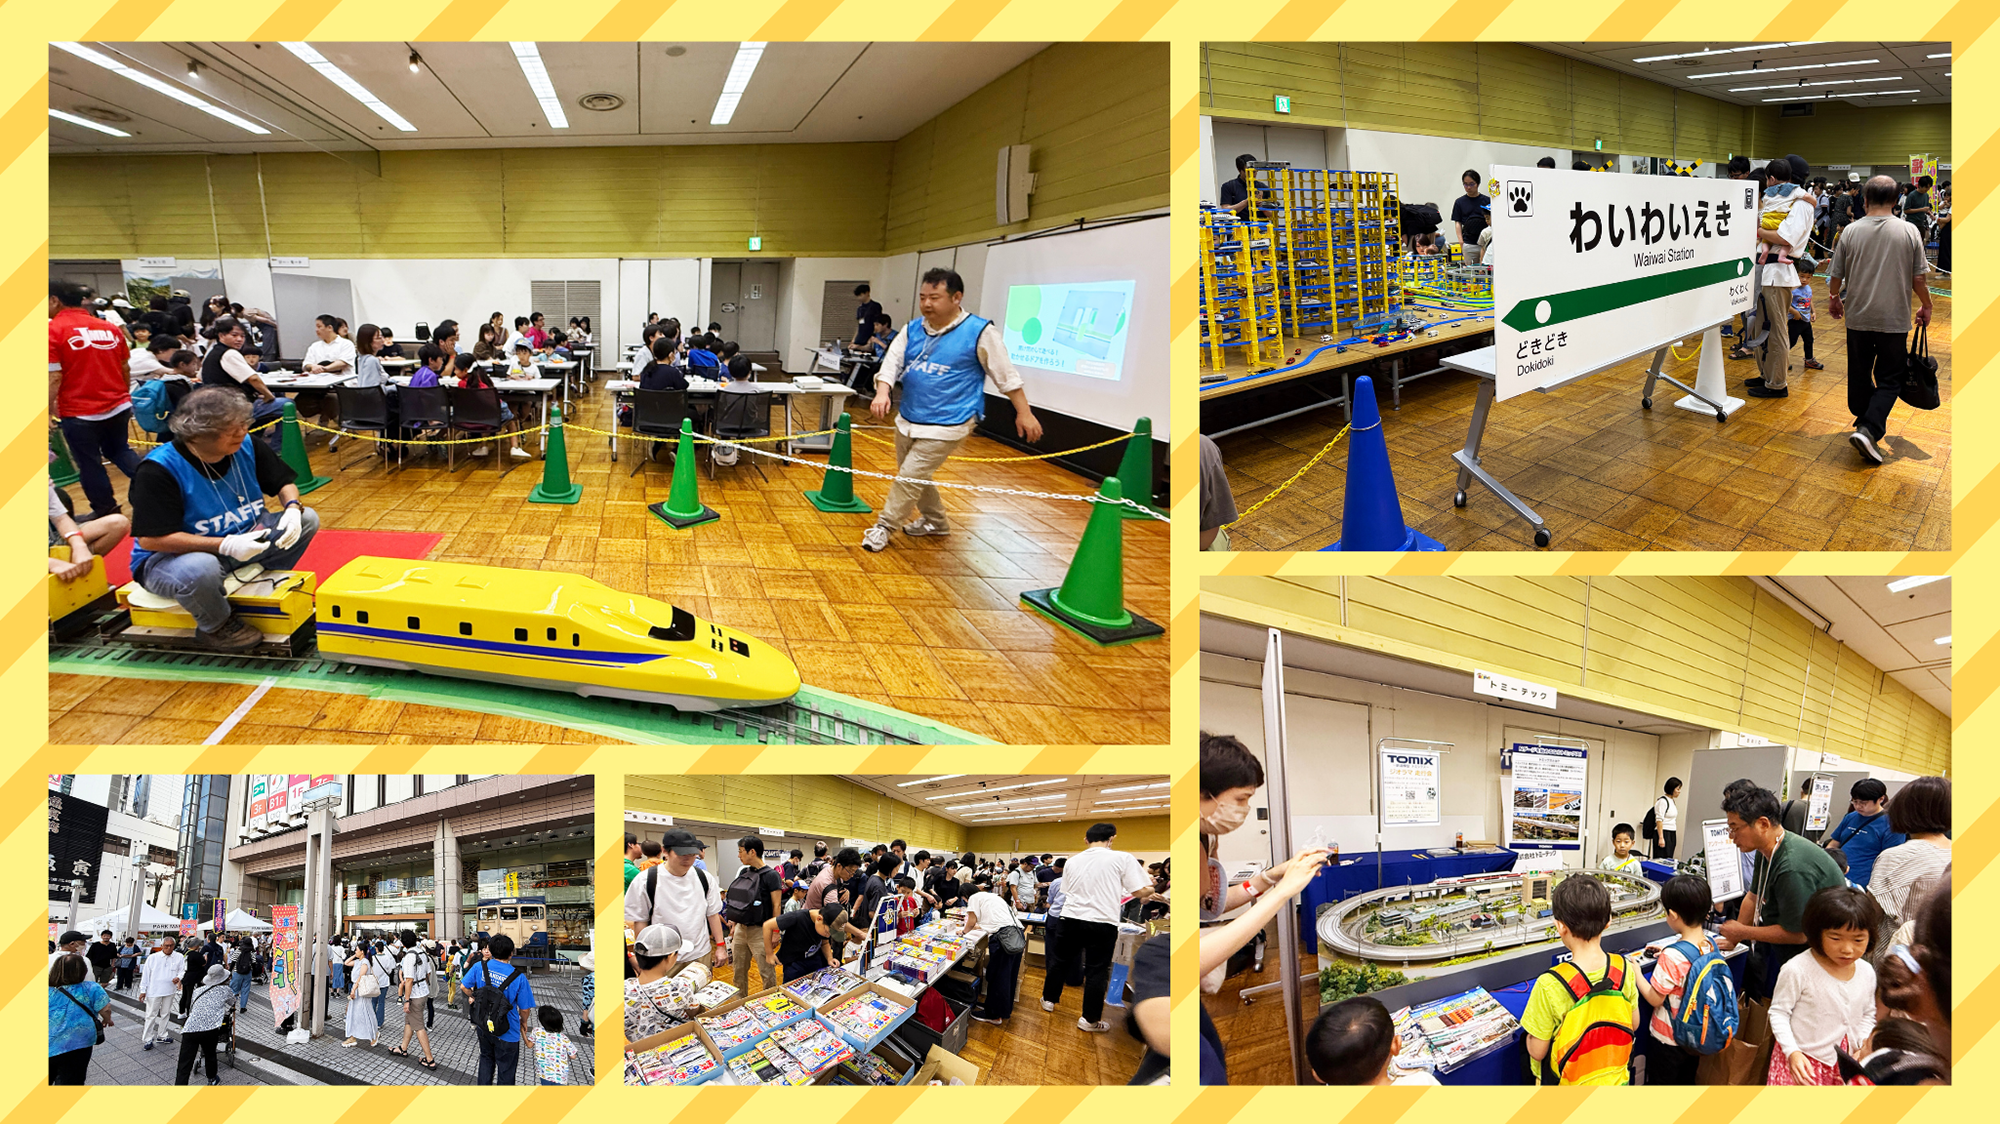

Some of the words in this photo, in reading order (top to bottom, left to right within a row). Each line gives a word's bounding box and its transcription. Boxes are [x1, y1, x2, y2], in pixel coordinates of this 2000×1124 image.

[1569, 200, 1732, 253] わいわいえき
[1634, 251, 1666, 268] Waiwai
[1667, 247, 1695, 263] Station
[1729, 282, 1749, 297] わくわく
[1516, 331, 1568, 360] どきどき
[1516, 355, 1554, 377] Dokidoki
[194, 499, 264, 536] STAFF
[1490, 680, 1547, 700] トミーテック
[1387, 755, 1433, 765] TOMIX
[292, 786, 304, 799] 1F
[253, 803, 262, 815] 3F
[269, 795, 284, 809] B1F
[1518, 850, 1557, 860] 式会社トミーテック
